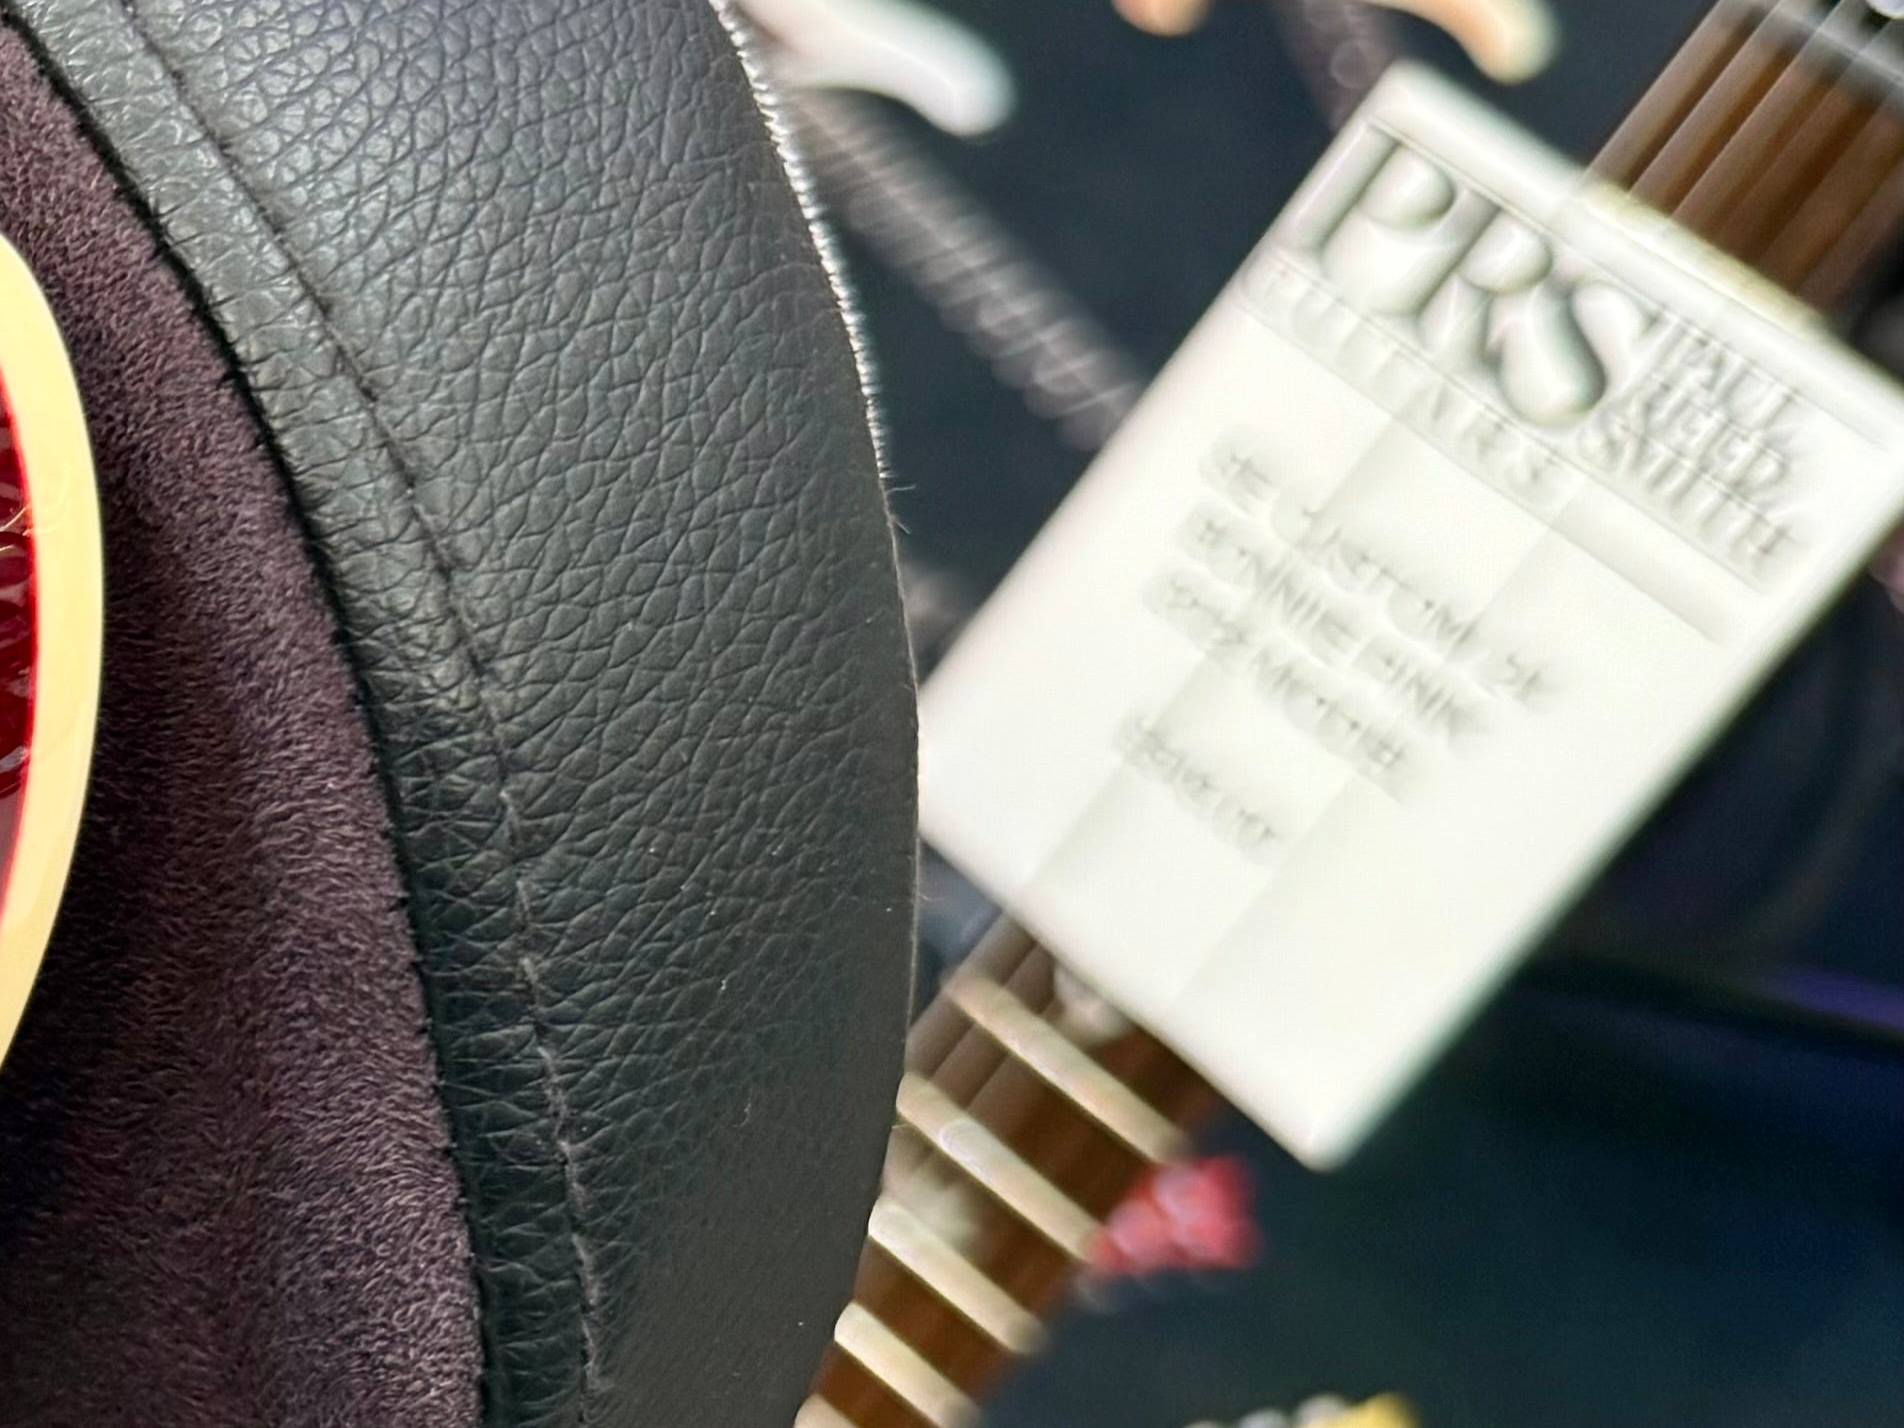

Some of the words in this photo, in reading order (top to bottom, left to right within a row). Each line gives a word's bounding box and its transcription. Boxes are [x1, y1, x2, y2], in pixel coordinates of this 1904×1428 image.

[1272, 114, 1664, 437] PRS
[1642, 316, 1804, 442] PAUL
[1568, 406, 1794, 570] SMITH
